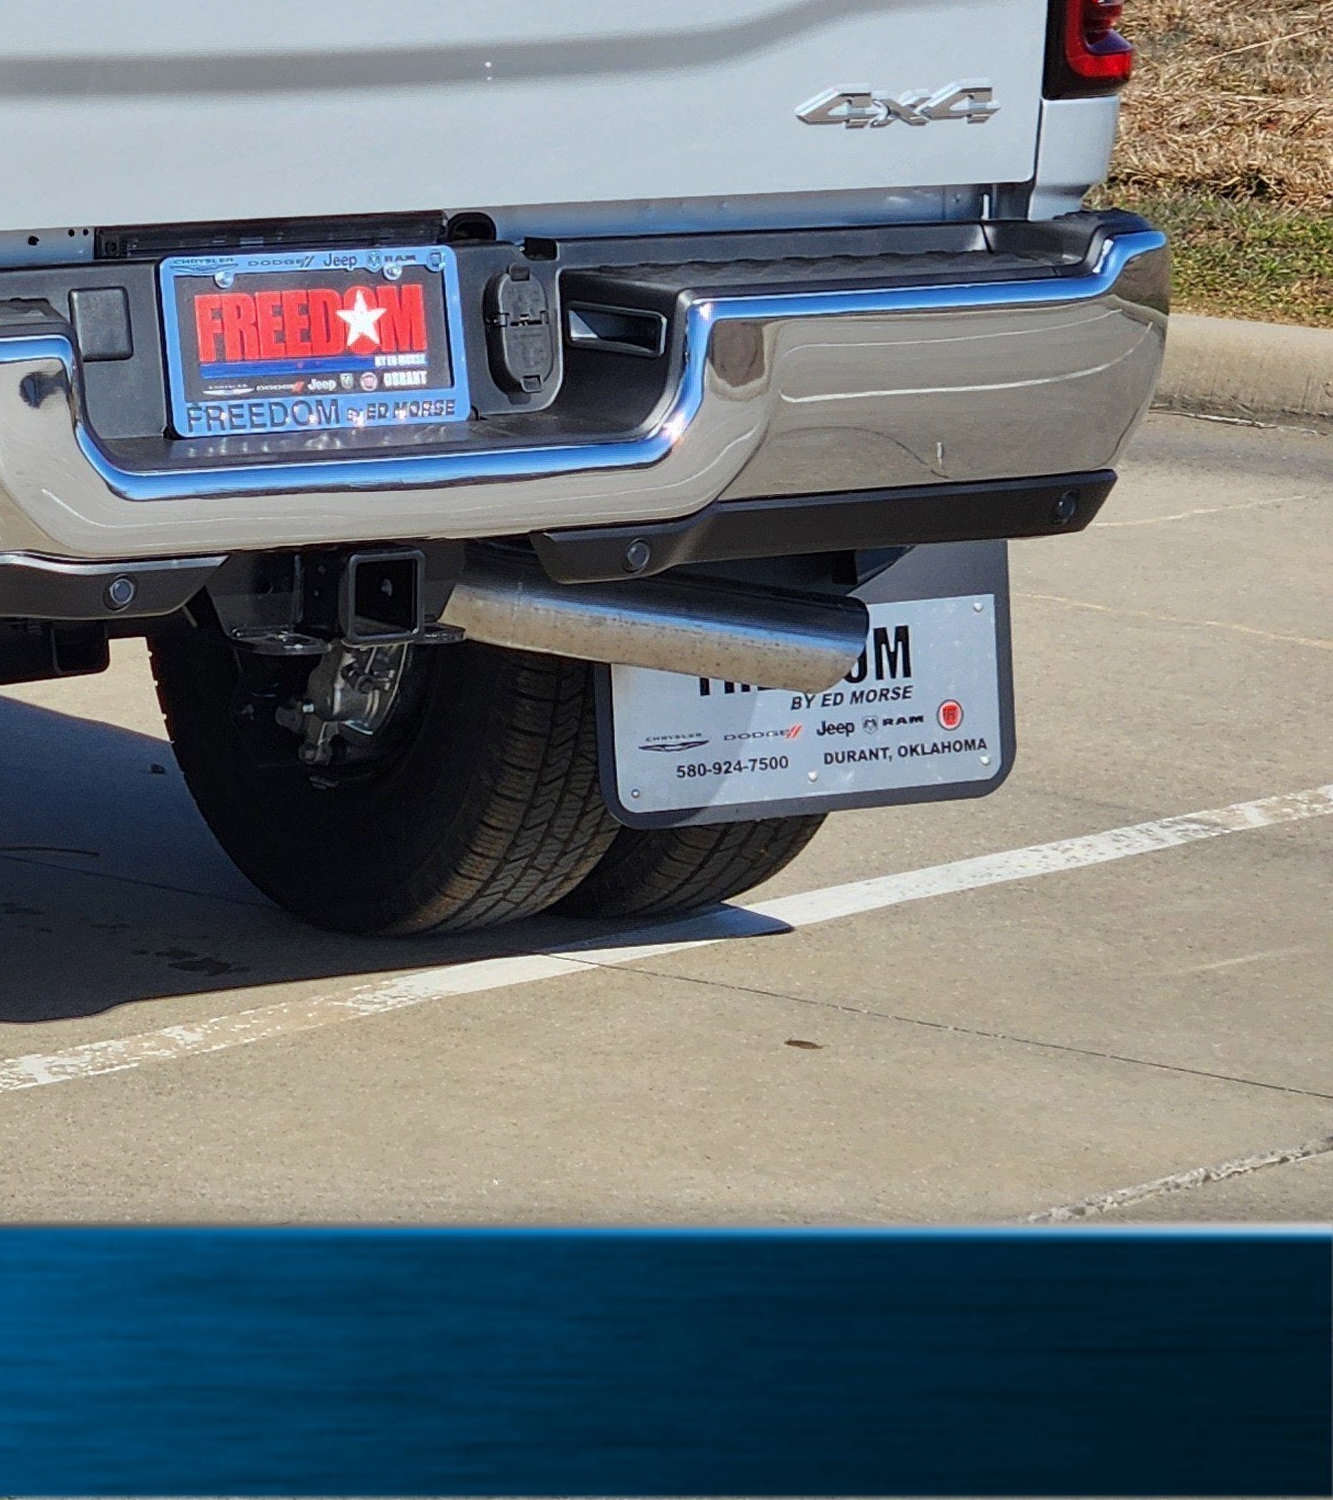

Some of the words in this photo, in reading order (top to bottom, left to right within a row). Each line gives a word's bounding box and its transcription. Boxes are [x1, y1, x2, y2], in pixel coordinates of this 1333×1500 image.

[248, 258, 302, 267] DODGE
[323, 253, 358, 268] Jeep
[307, 378, 337, 391] Jeep
[187, 398, 340, 432] FREEDOM
[790, 694, 816, 711] BY
[821, 692, 844, 708] ED
[849, 685, 914, 706] MORSE
[645, 732, 703, 742] CHRYSLER
[724, 729, 790, 741] DODGE
[816, 720, 855, 737] Jeep
[882, 715, 925, 727] RAM
[823, 747, 893, 765] DURANT,
[897, 738, 988, 758] OKLAHOMA
[676, 755, 789, 779] 580-924-7500
